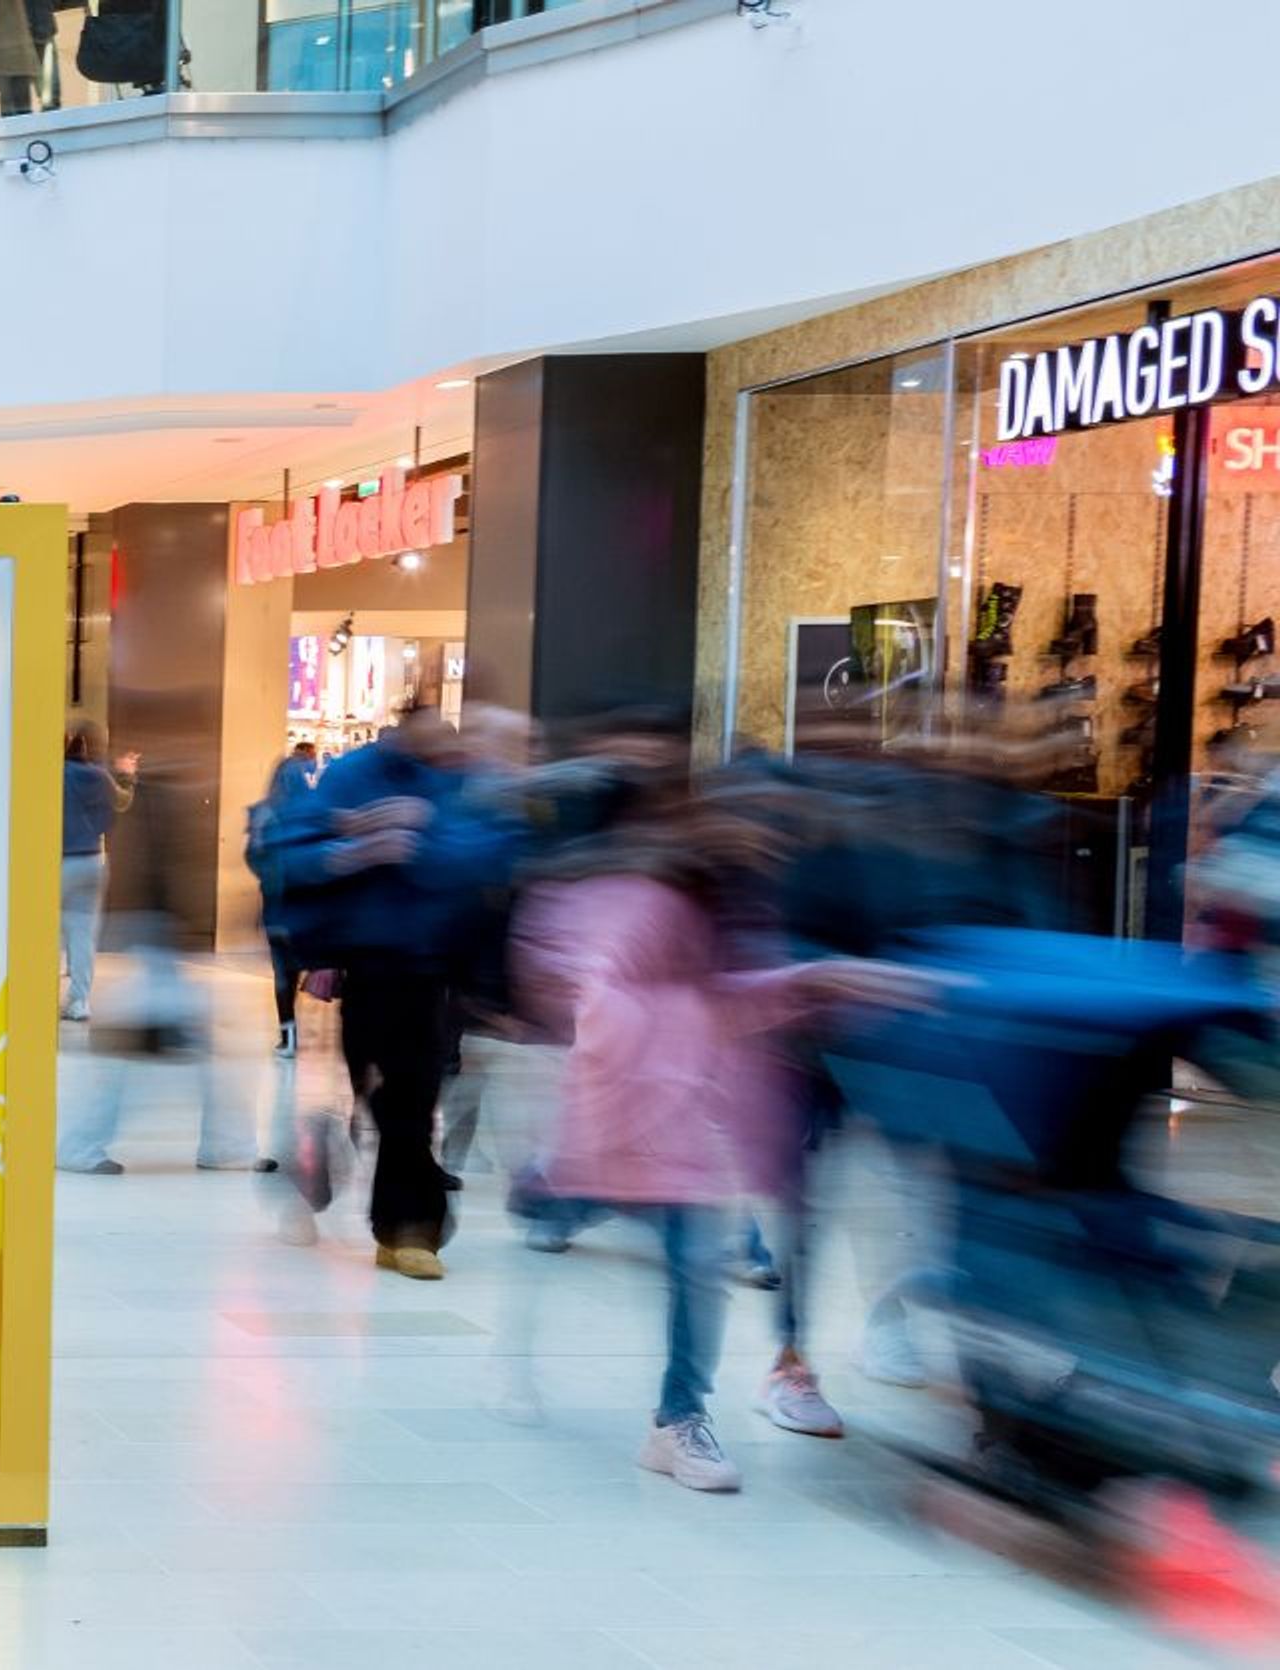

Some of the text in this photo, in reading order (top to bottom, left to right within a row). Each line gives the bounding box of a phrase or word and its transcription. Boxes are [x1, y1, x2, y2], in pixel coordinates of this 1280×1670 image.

[997, 297, 1280, 441] DAMAGED S
[237, 467, 462, 585] Foot Locker
